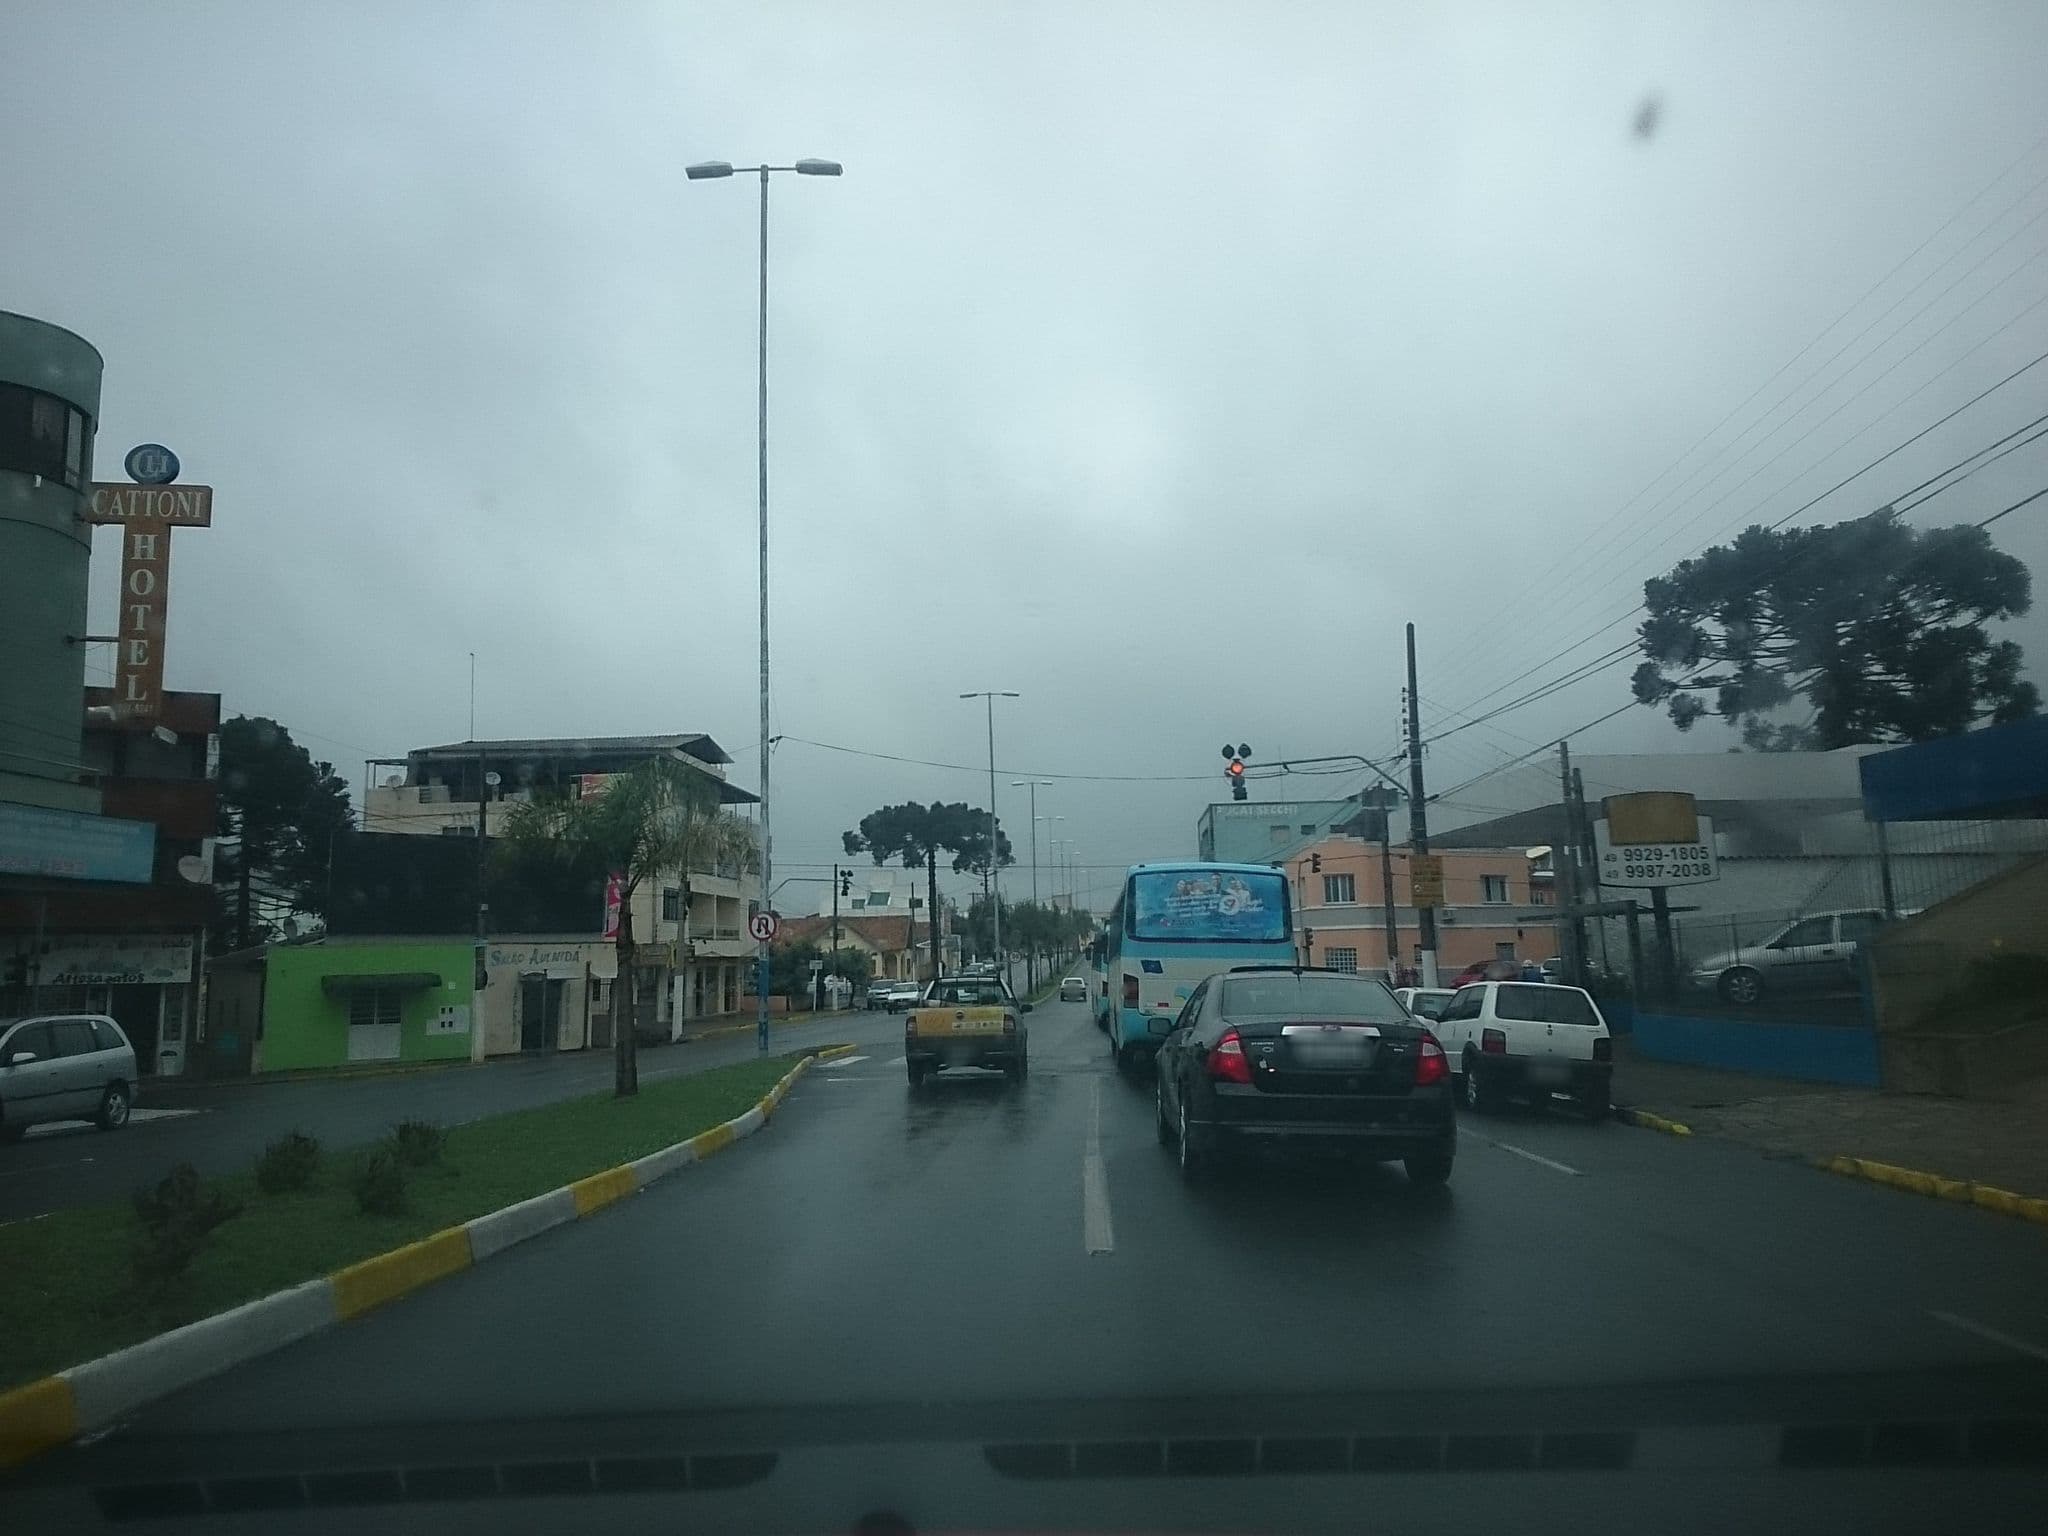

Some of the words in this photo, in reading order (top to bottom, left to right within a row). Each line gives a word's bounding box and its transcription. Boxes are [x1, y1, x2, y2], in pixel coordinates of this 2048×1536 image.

[91, 488, 204, 519] CATTONI
[126, 533, 158, 701] HOTEL
[1623, 846, 1709, 862] 9929-1805
[1625, 863, 1712, 878] 9987-2038
